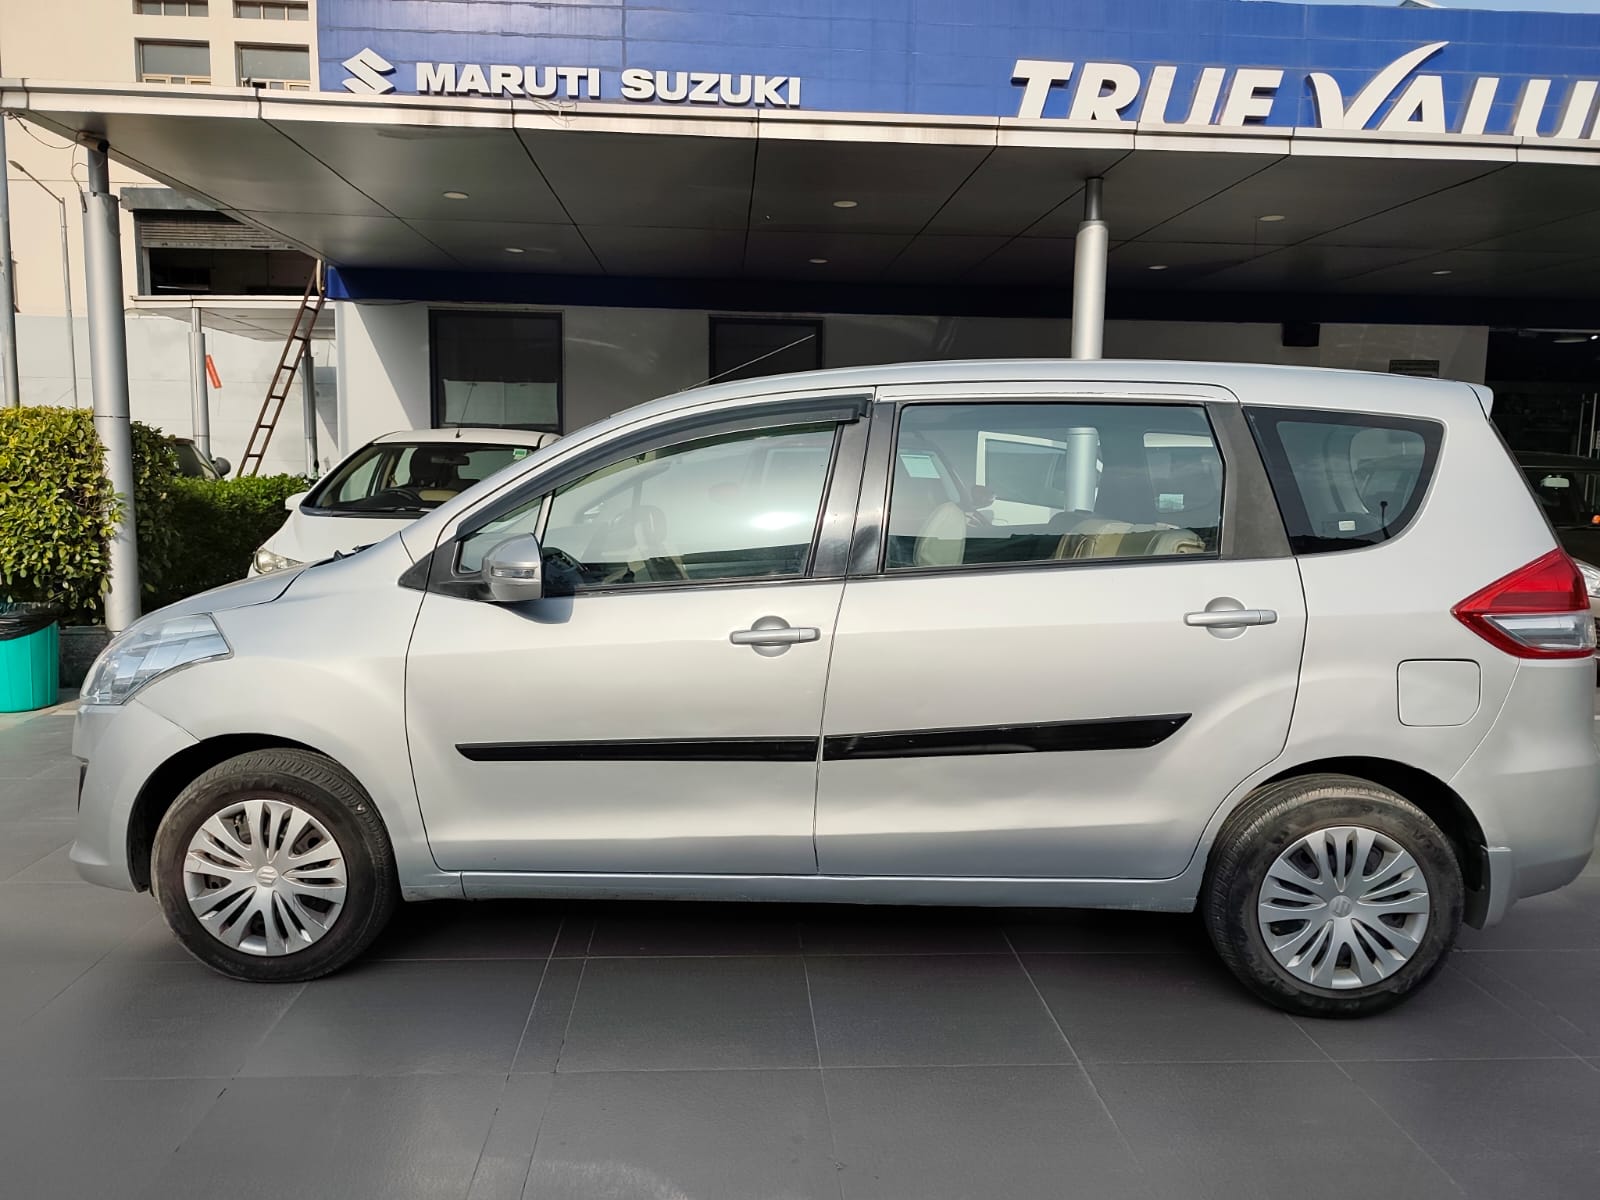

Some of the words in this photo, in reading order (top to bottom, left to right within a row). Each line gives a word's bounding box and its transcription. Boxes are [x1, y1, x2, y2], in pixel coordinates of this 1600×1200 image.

[416, 62, 600, 99] MARUTI
[621, 68, 801, 106] SUZUKI
[1011, 59, 1284, 126] TRUE
[1309, 41, 1600, 140] VALU
